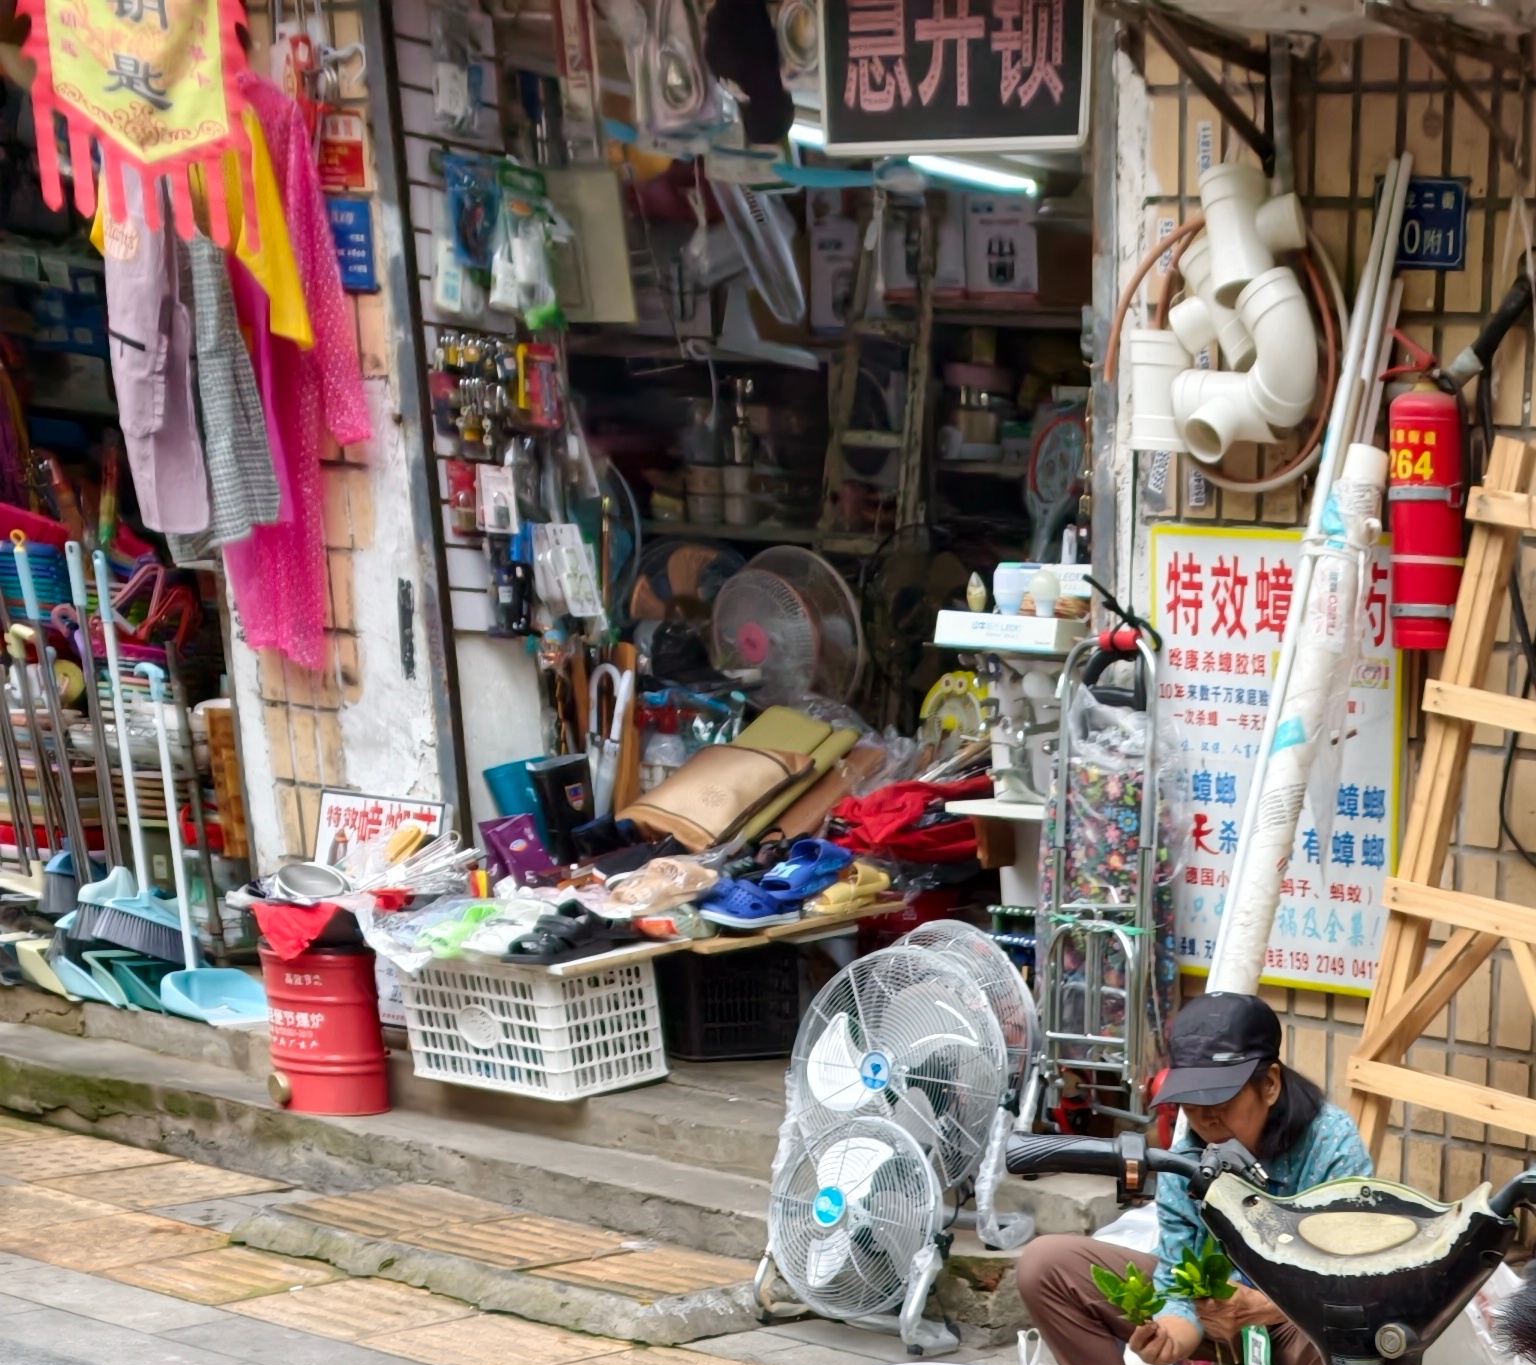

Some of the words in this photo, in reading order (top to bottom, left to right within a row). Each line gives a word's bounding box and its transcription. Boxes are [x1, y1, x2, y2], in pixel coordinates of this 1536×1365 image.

[1226, 713, 1266, 731] 一年无
[1290, 828, 1386, 871] 有蟑螂
[1316, 954, 1345, 977] 2749
[1351, 961, 1380, 980] 041
